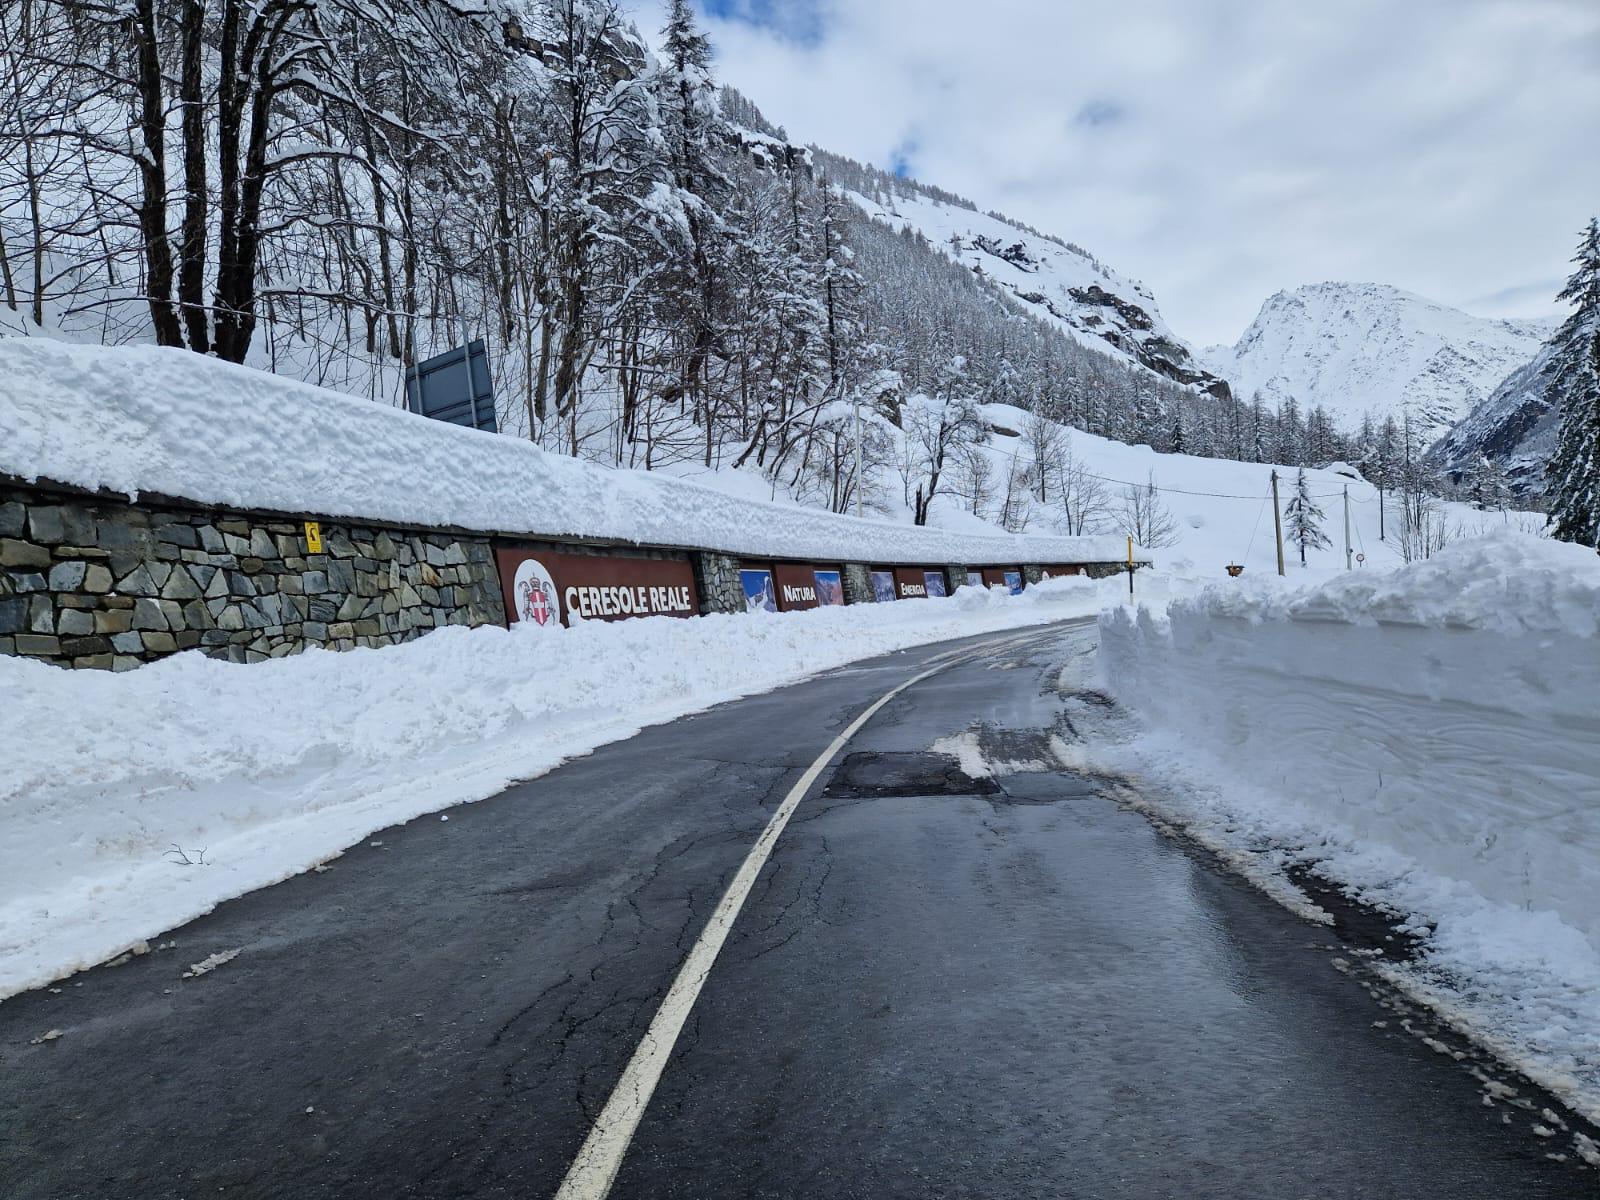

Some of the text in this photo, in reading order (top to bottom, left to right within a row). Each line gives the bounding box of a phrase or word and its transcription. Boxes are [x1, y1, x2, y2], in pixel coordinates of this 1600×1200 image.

[565, 586, 692, 617] CERESOLE REALE
[783, 584, 817, 602] NATURA
